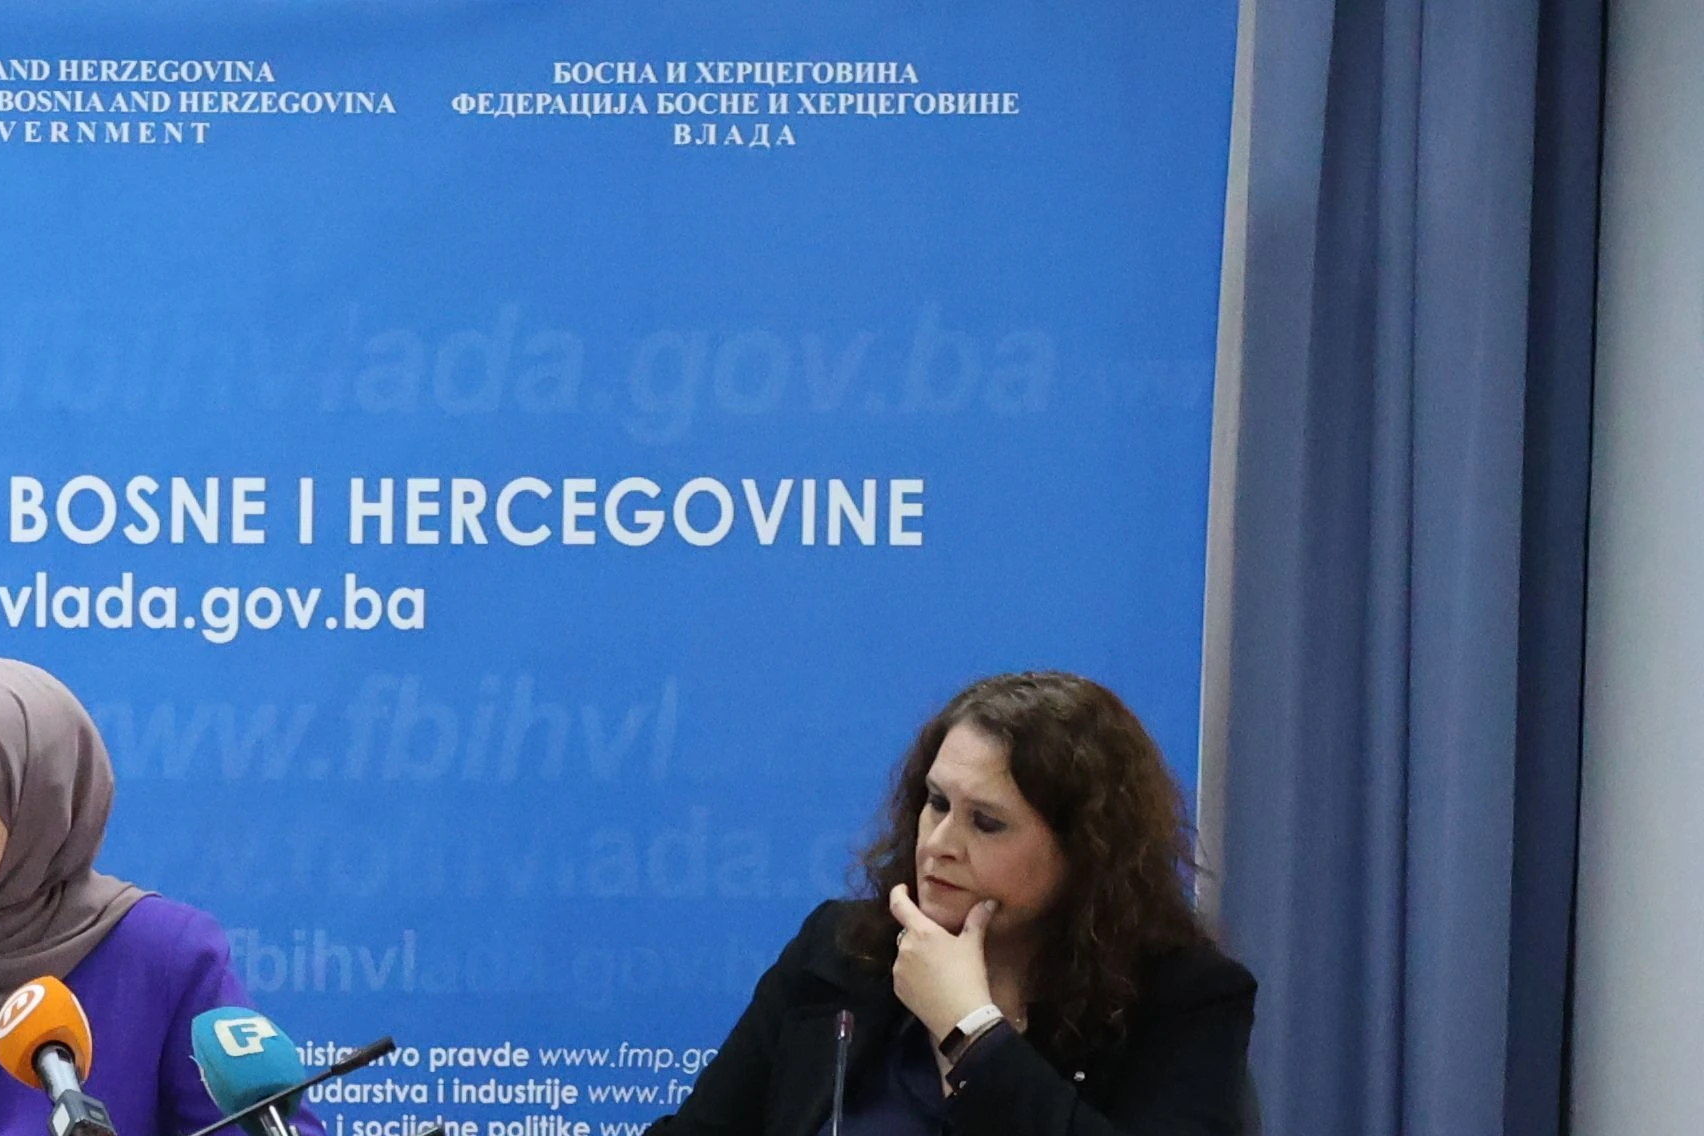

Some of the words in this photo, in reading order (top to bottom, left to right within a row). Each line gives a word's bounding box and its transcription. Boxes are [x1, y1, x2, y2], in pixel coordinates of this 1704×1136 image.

[59, 60, 275, 82] HERZEGOVINA
[554, 62, 657, 83] БОСНА
[667, 62, 686, 83] И
[696, 62, 918, 86] ХЕРЦЕГОВИНА
[109, 91, 171, 112] AND
[180, 92, 395, 113] HERZEGOVINA
[452, 93, 648, 117] ФЕДЕРАЦИЈА
[657, 93, 758, 114] БОСНЕ
[769, 93, 788, 114] И
[797, 93, 1019, 117] ХЕРЦЕГОВИНЕ
[675, 124, 795, 147] ВЛАДА
[11, 475, 265, 544] BOSNE
[300, 478, 313, 544] I
[350, 477, 923, 546] HERCEGOVINE
[430, 1042, 529, 1072] pravde
[539, 1041, 718, 1074] www.fmp.go
[308, 1079, 428, 1104] udarstva
[438, 1078, 444, 1103] i
[454, 1078, 578, 1110] industrije
